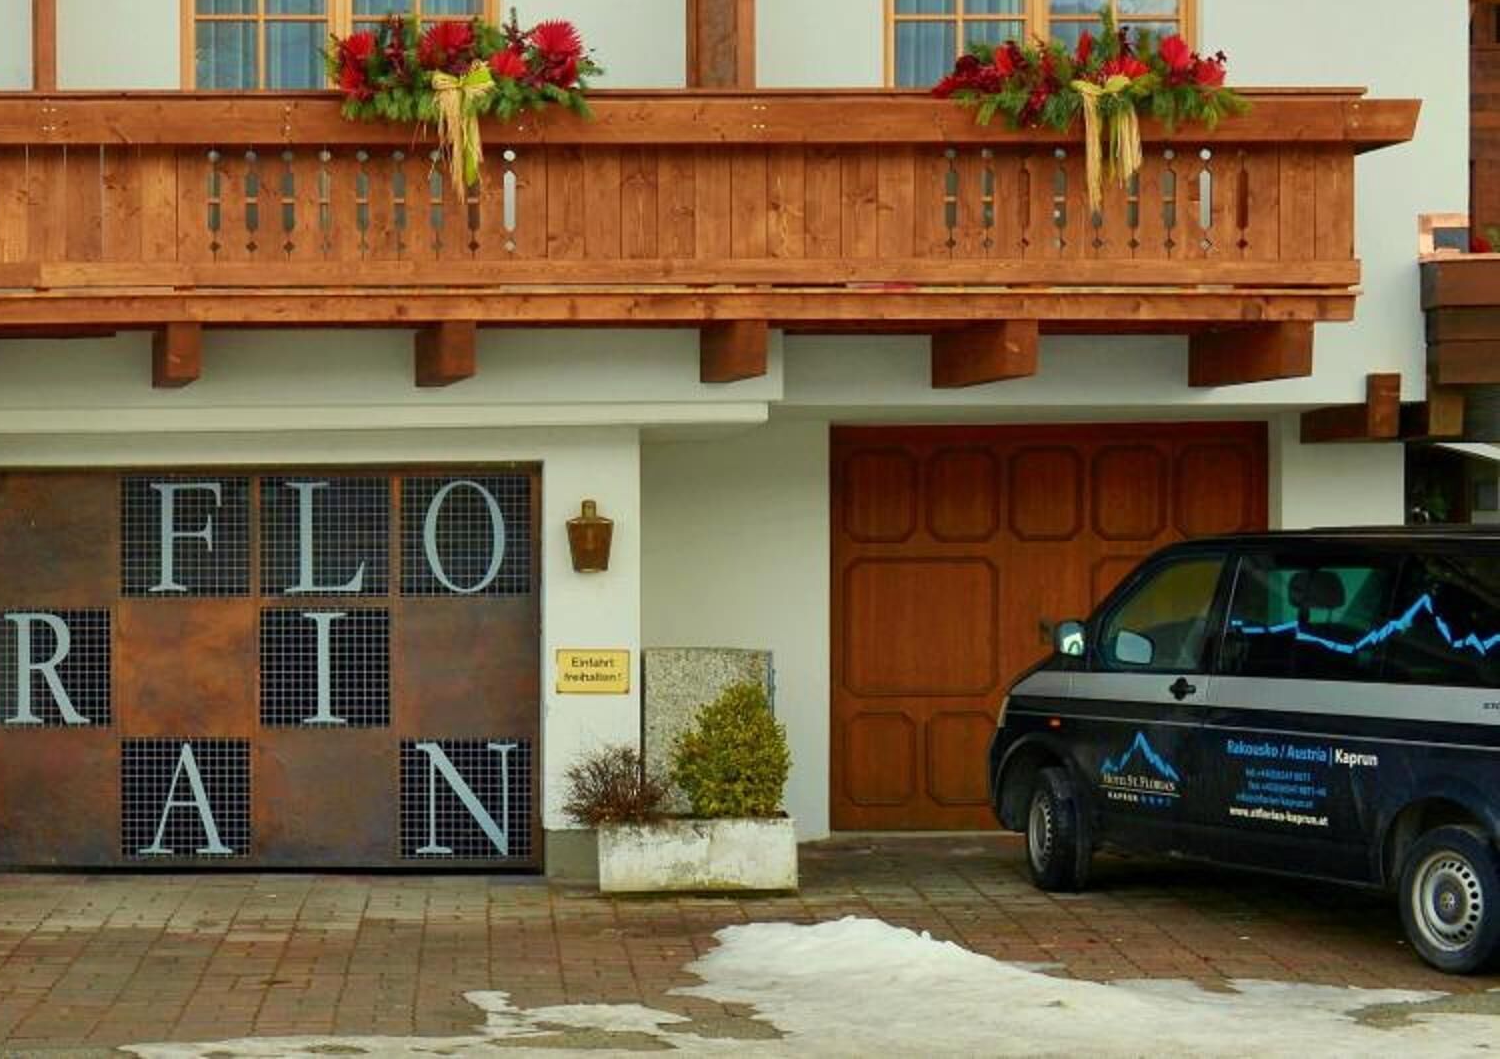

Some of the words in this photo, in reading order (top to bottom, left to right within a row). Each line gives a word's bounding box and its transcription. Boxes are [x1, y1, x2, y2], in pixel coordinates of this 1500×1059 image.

[571, 656, 614, 668] Einfahrt
[1287, 743, 1327, 762] Austria
[1334, 747, 1379, 768] Kaprun
